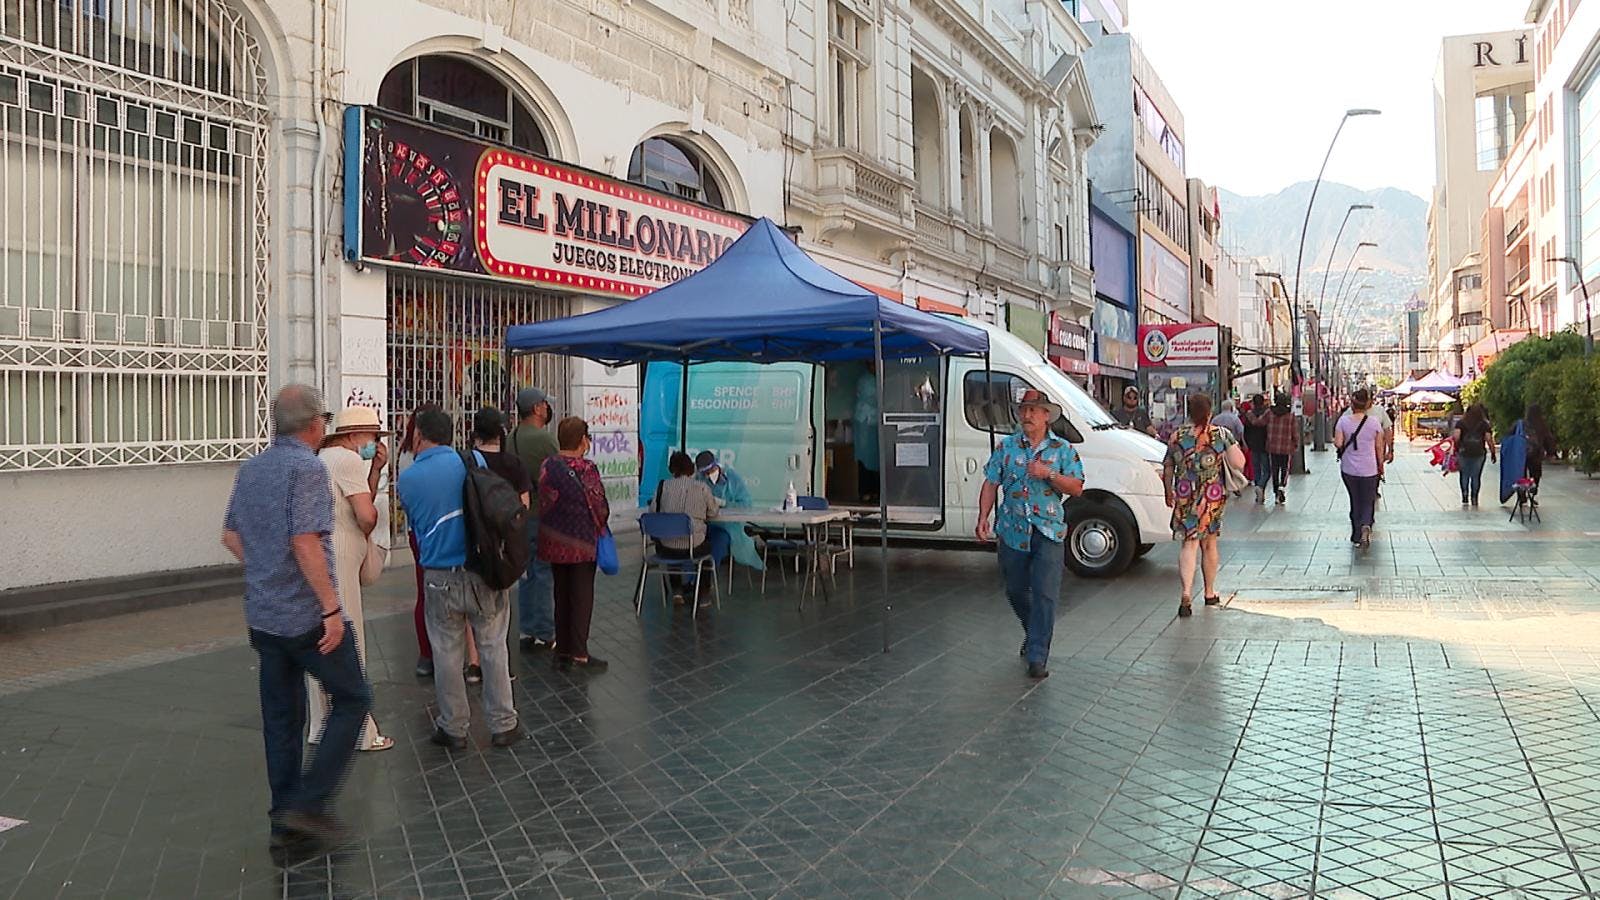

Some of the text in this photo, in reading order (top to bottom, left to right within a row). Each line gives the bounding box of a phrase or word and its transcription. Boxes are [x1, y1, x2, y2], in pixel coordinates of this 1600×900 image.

[498, 177, 547, 232] EL
[553, 241, 617, 273] JUEGOS
[714, 386, 759, 397] SPENCE
[691, 399, 759, 409] ESCONDIDA
